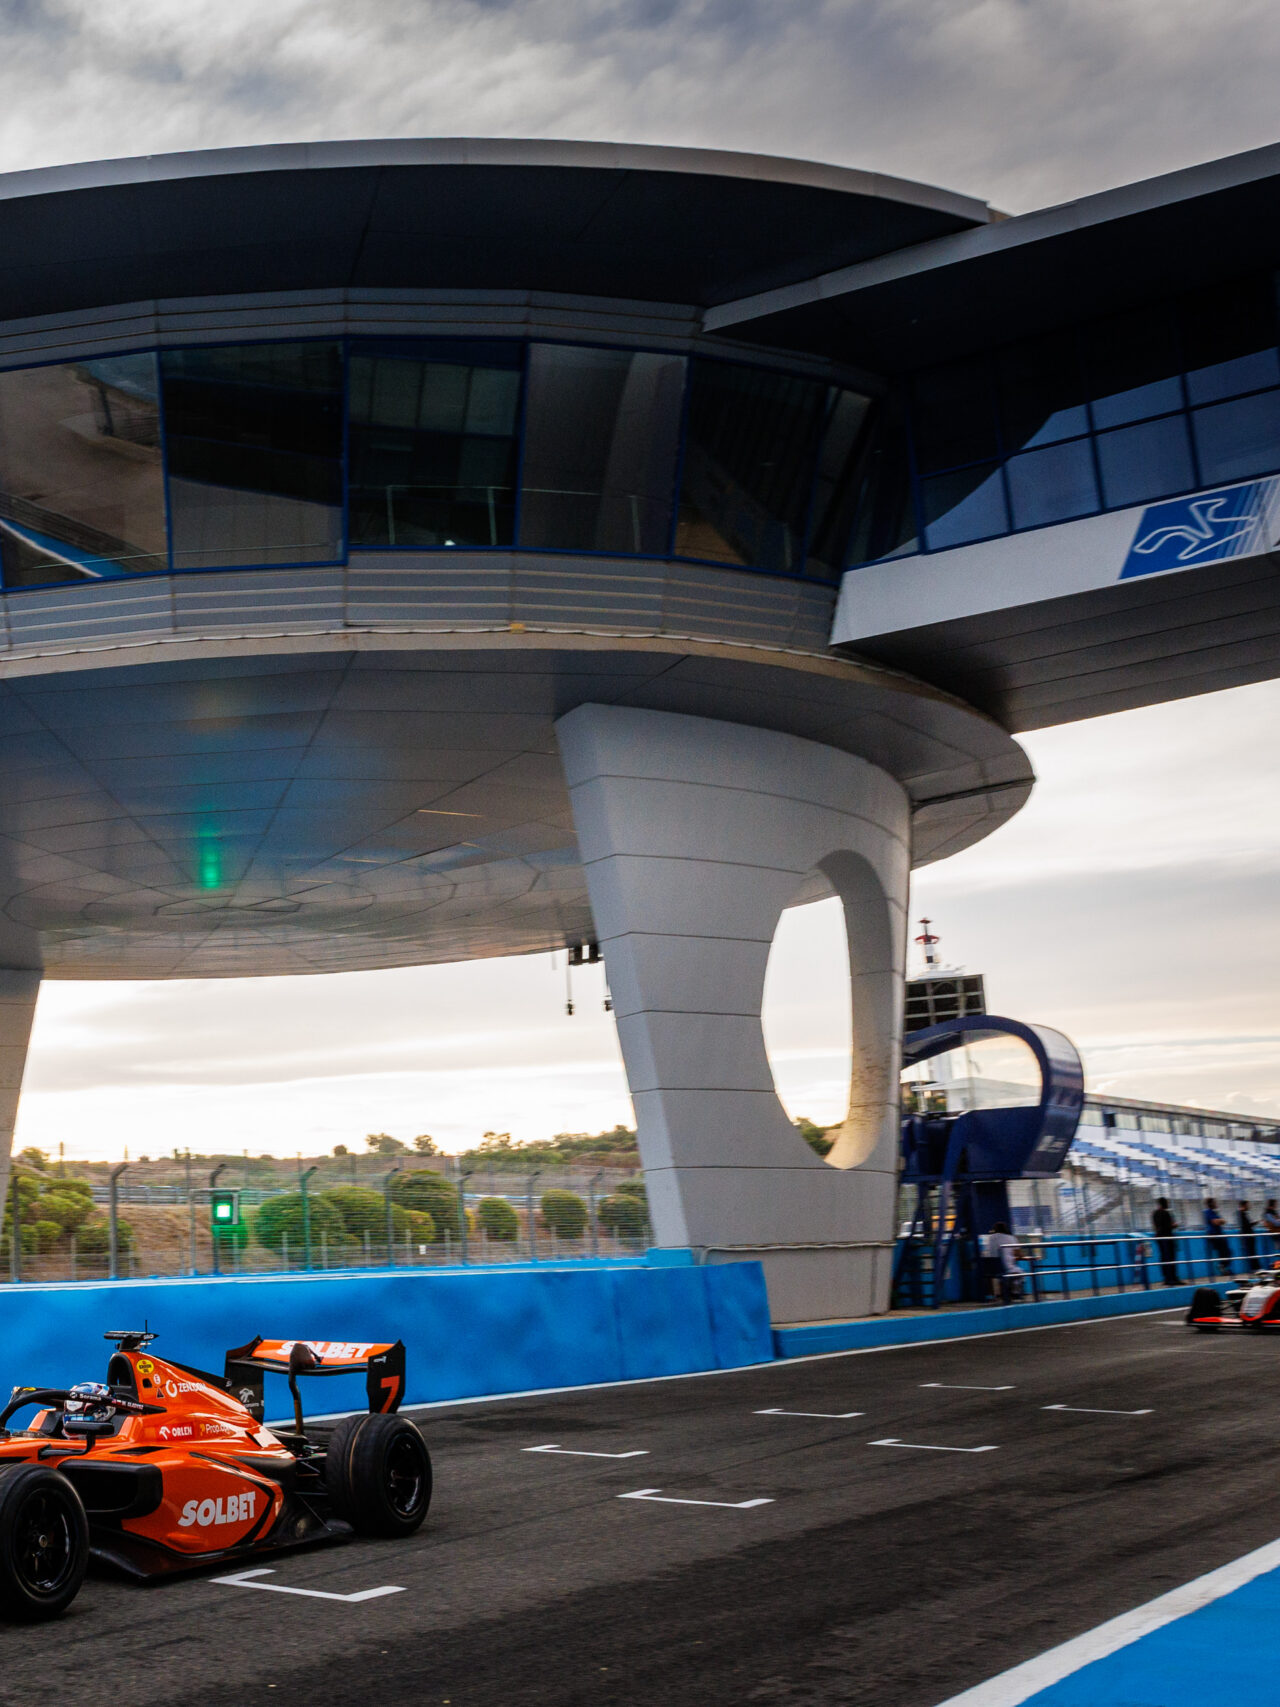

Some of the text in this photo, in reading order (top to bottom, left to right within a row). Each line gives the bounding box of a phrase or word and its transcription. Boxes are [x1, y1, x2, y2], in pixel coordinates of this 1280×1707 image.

[381, 1375, 400, 1414] 7
[171, 1426, 193, 1437] ORLEN
[177, 1491, 256, 1527] SOLBET
